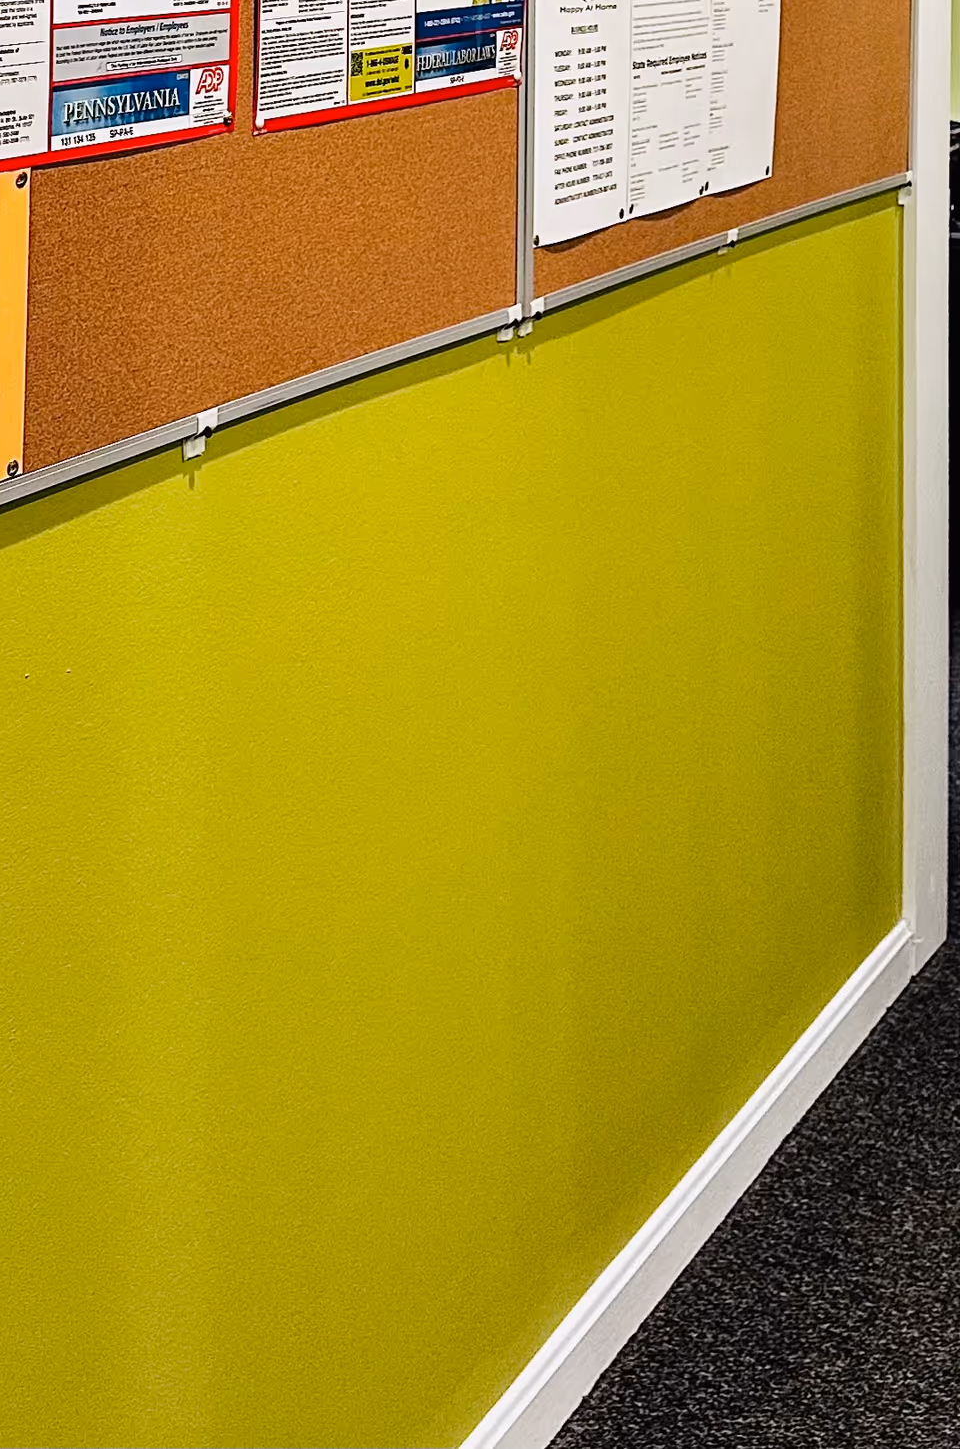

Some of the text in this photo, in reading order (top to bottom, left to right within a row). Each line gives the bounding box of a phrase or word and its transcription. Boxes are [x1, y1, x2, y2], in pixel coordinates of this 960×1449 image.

[417, 44, 495, 72] FEDERAL LABOR LAWS
[195, 67, 224, 94] ADP
[64, 89, 179, 122] PENNSYLVANIA
